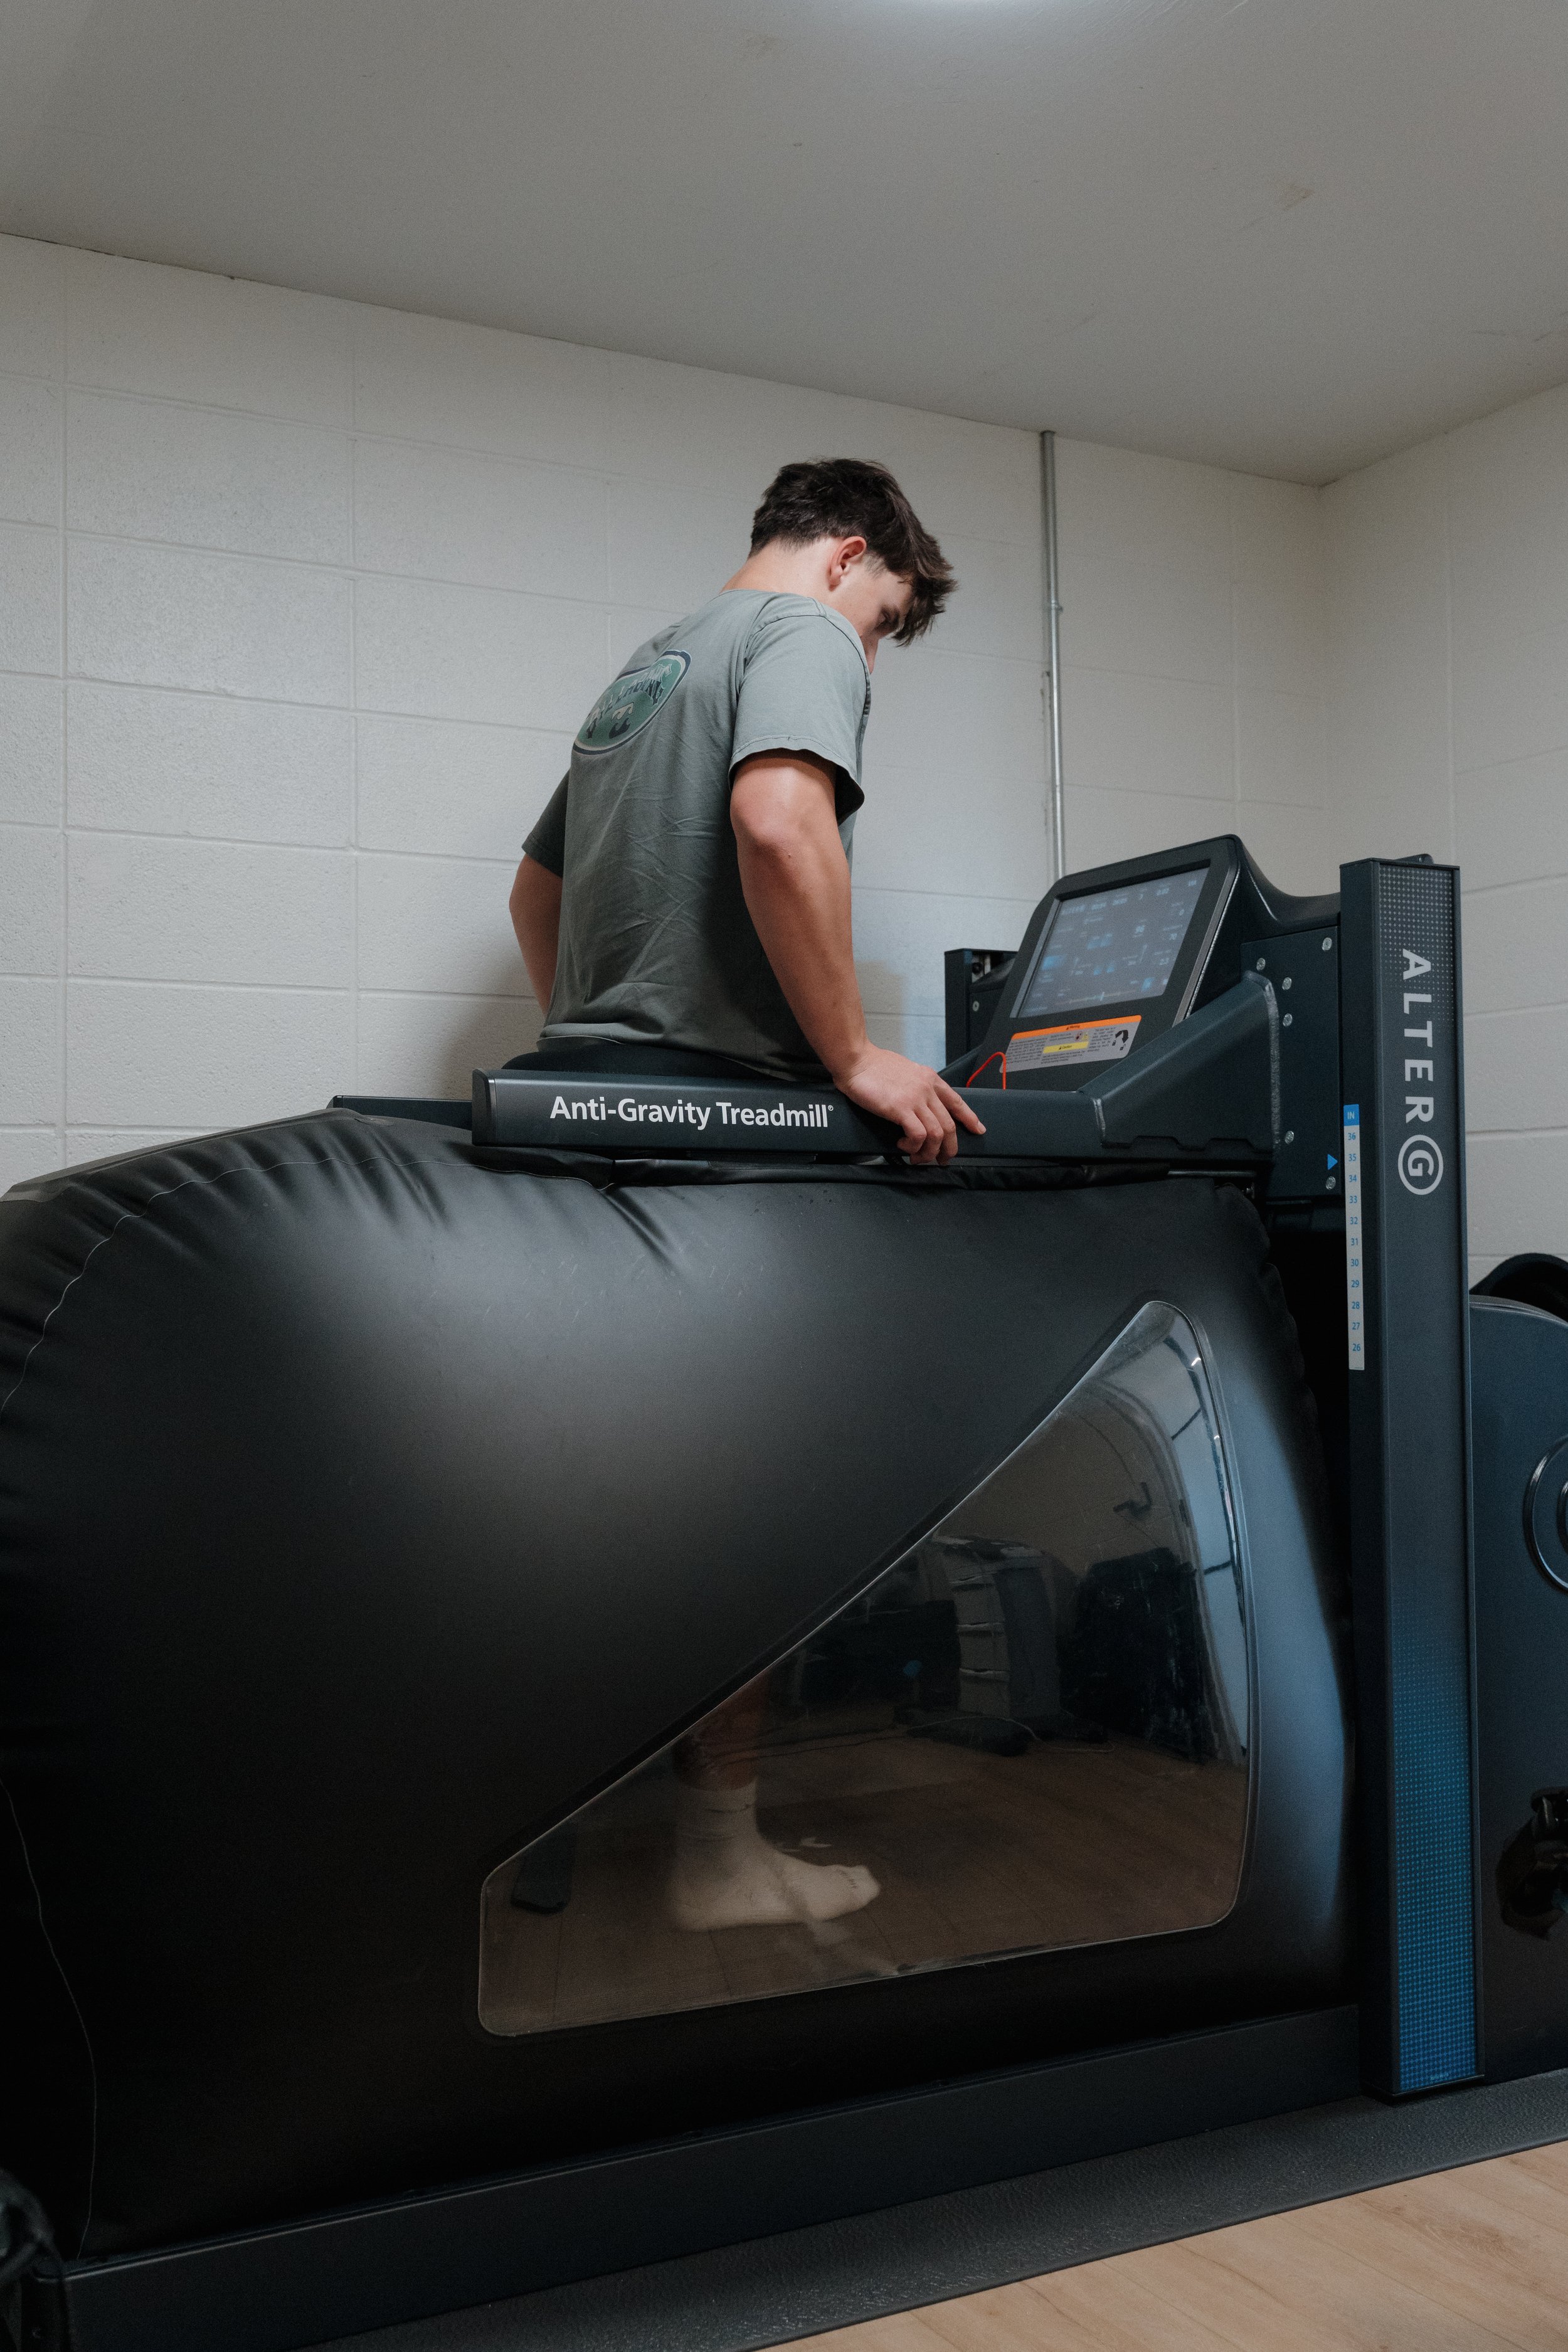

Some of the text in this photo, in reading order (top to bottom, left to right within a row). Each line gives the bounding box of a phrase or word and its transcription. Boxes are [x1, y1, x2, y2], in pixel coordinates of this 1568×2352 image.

[549, 1096, 711, 1130] Anti-Gravity
[1347, 1111, 1355, 1120] IN
[1347, 1132, 1357, 1141] 36
[1348, 1153, 1357, 1162] 35
[1348, 1174, 1358, 1183] 34
[1349, 1195, 1358, 1204] 33
[1350, 1216, 1359, 1225] 32
[1350, 1237, 1359, 1246] 31
[1351, 1258, 1360, 1267] 30
[1351, 1279, 1360, 1288] 29
[1352, 1301, 1360, 1310] 28
[1352, 1322, 1360, 1330] 27
[1352, 1343, 1361, 1352] 26
